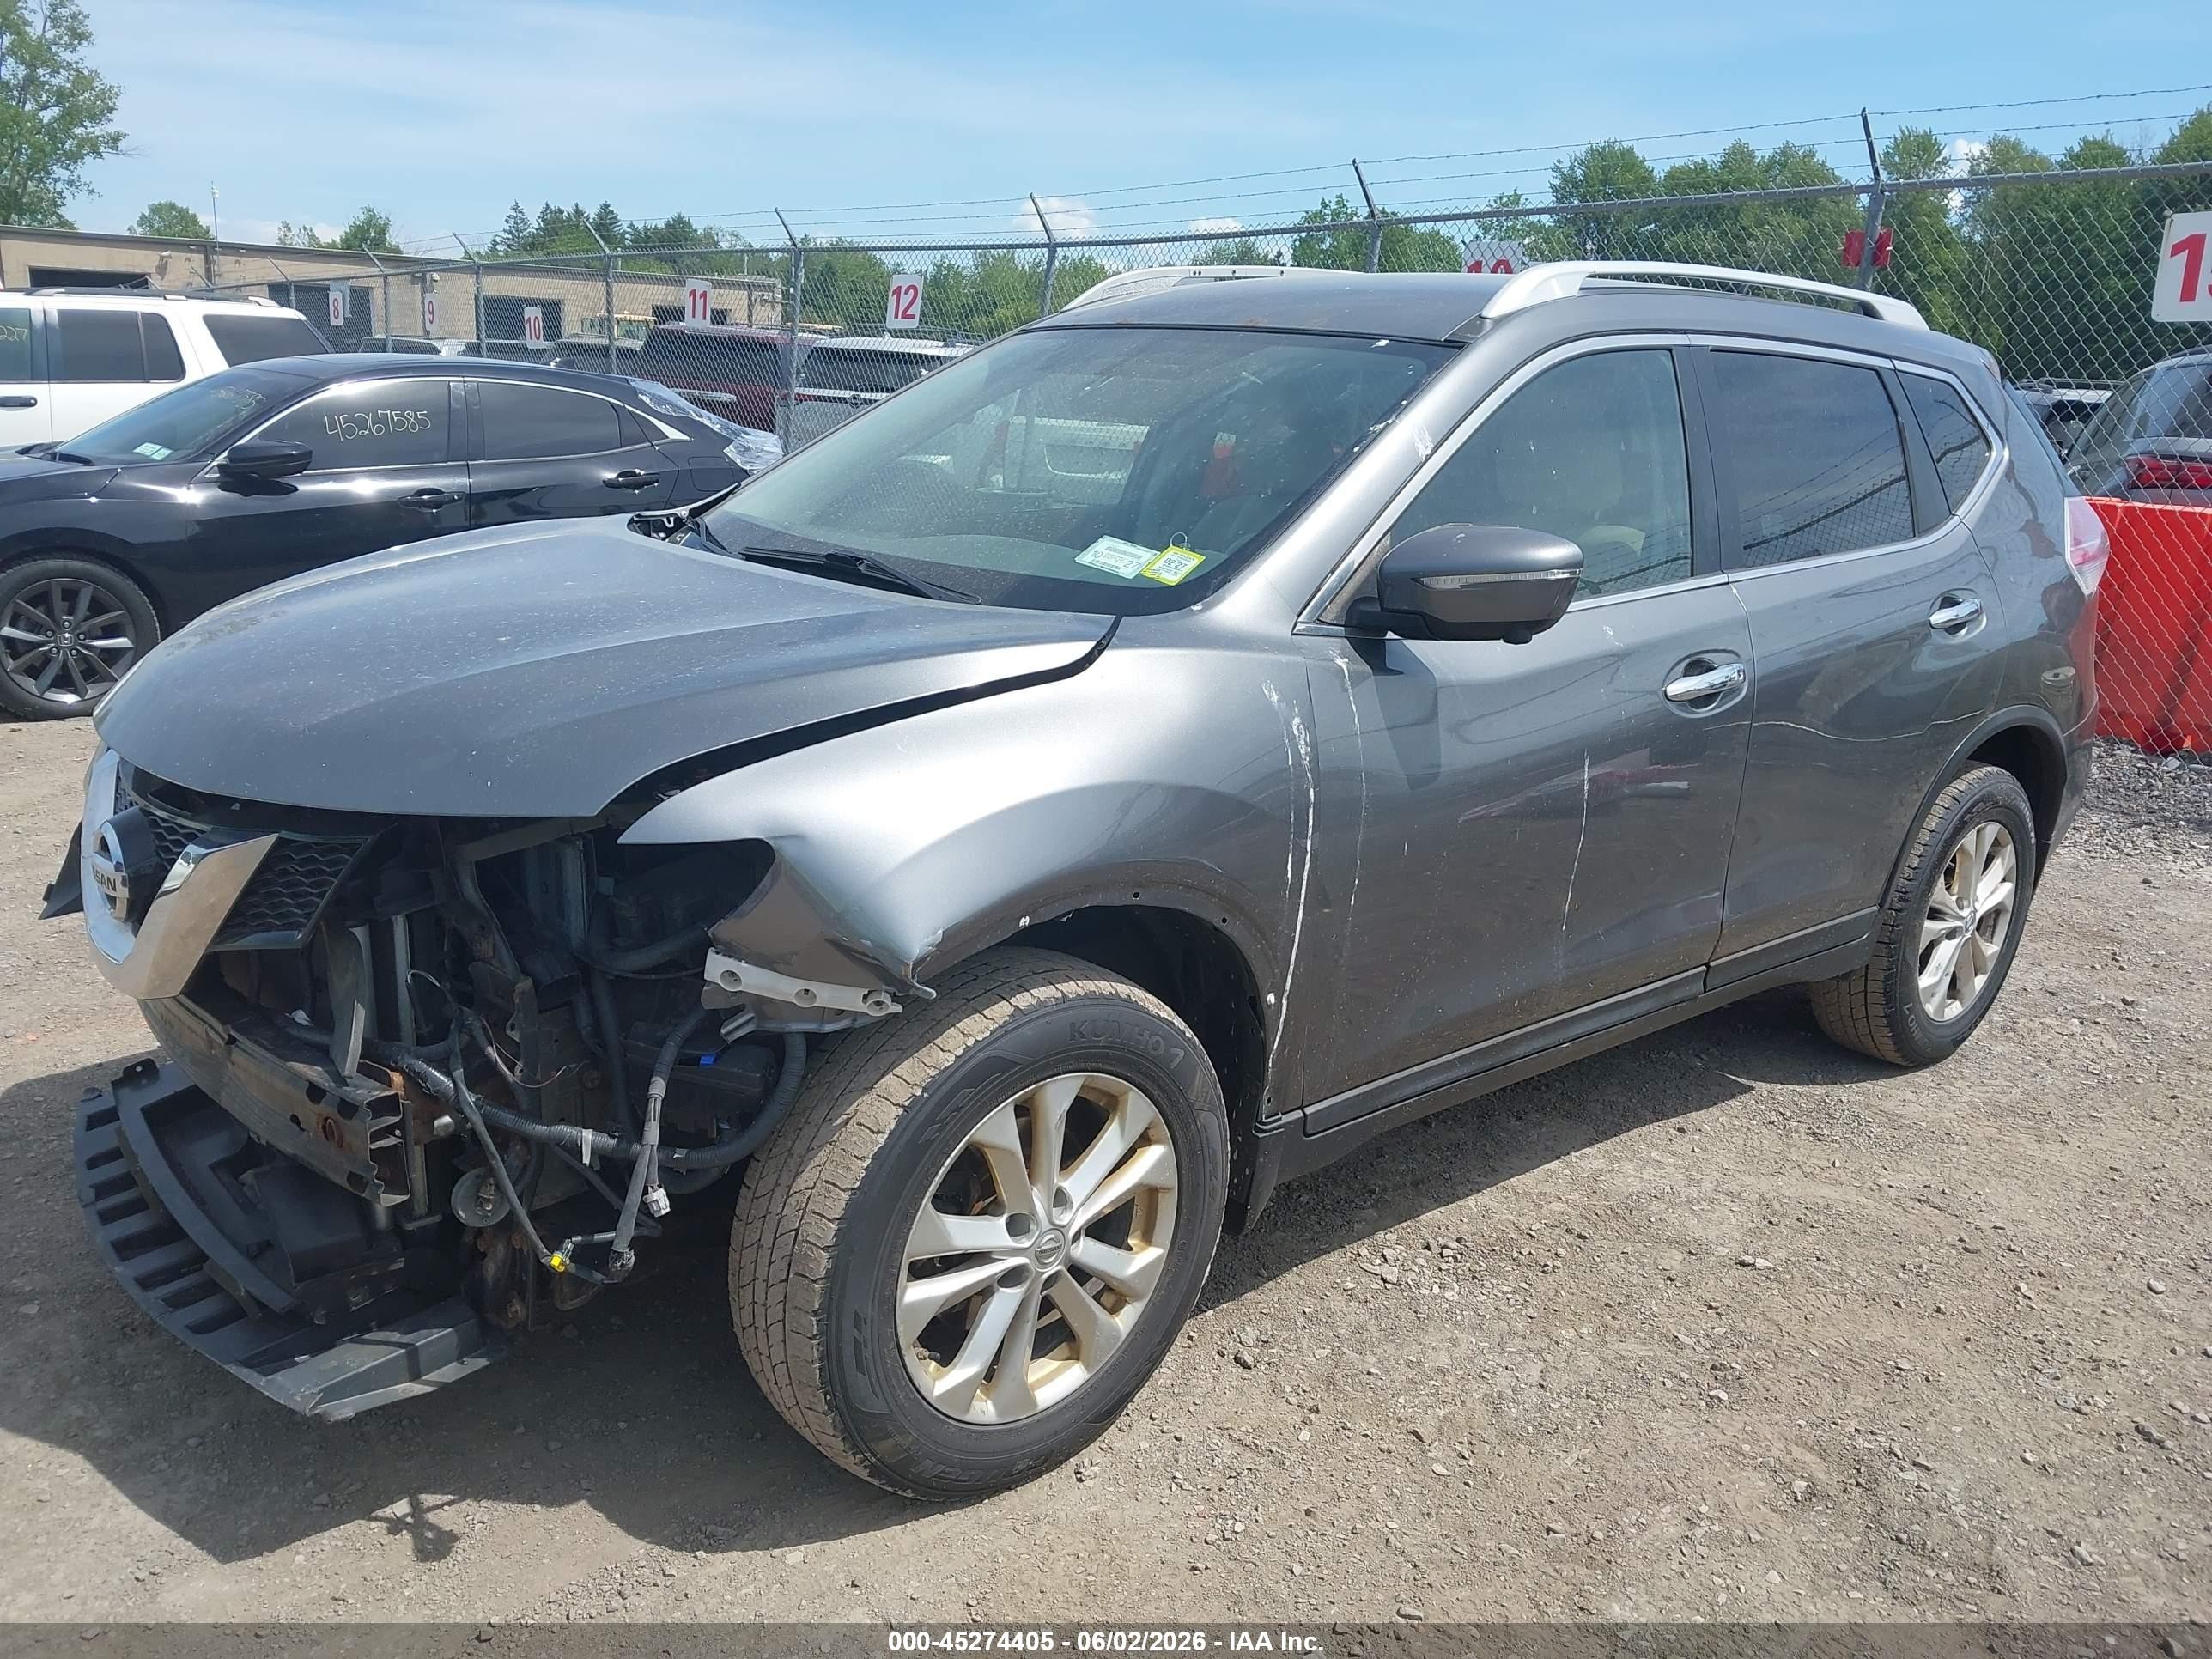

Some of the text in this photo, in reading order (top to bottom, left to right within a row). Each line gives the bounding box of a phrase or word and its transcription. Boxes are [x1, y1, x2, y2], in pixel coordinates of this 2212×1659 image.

[2170, 233, 2212, 303] 1
[332, 297, 340, 320] 8
[428, 301, 434, 325] 9
[688, 288, 708, 321] 11
[891, 284, 919, 320] 12
[526, 315, 541, 342] 10
[324, 410, 431, 441] 45267585
